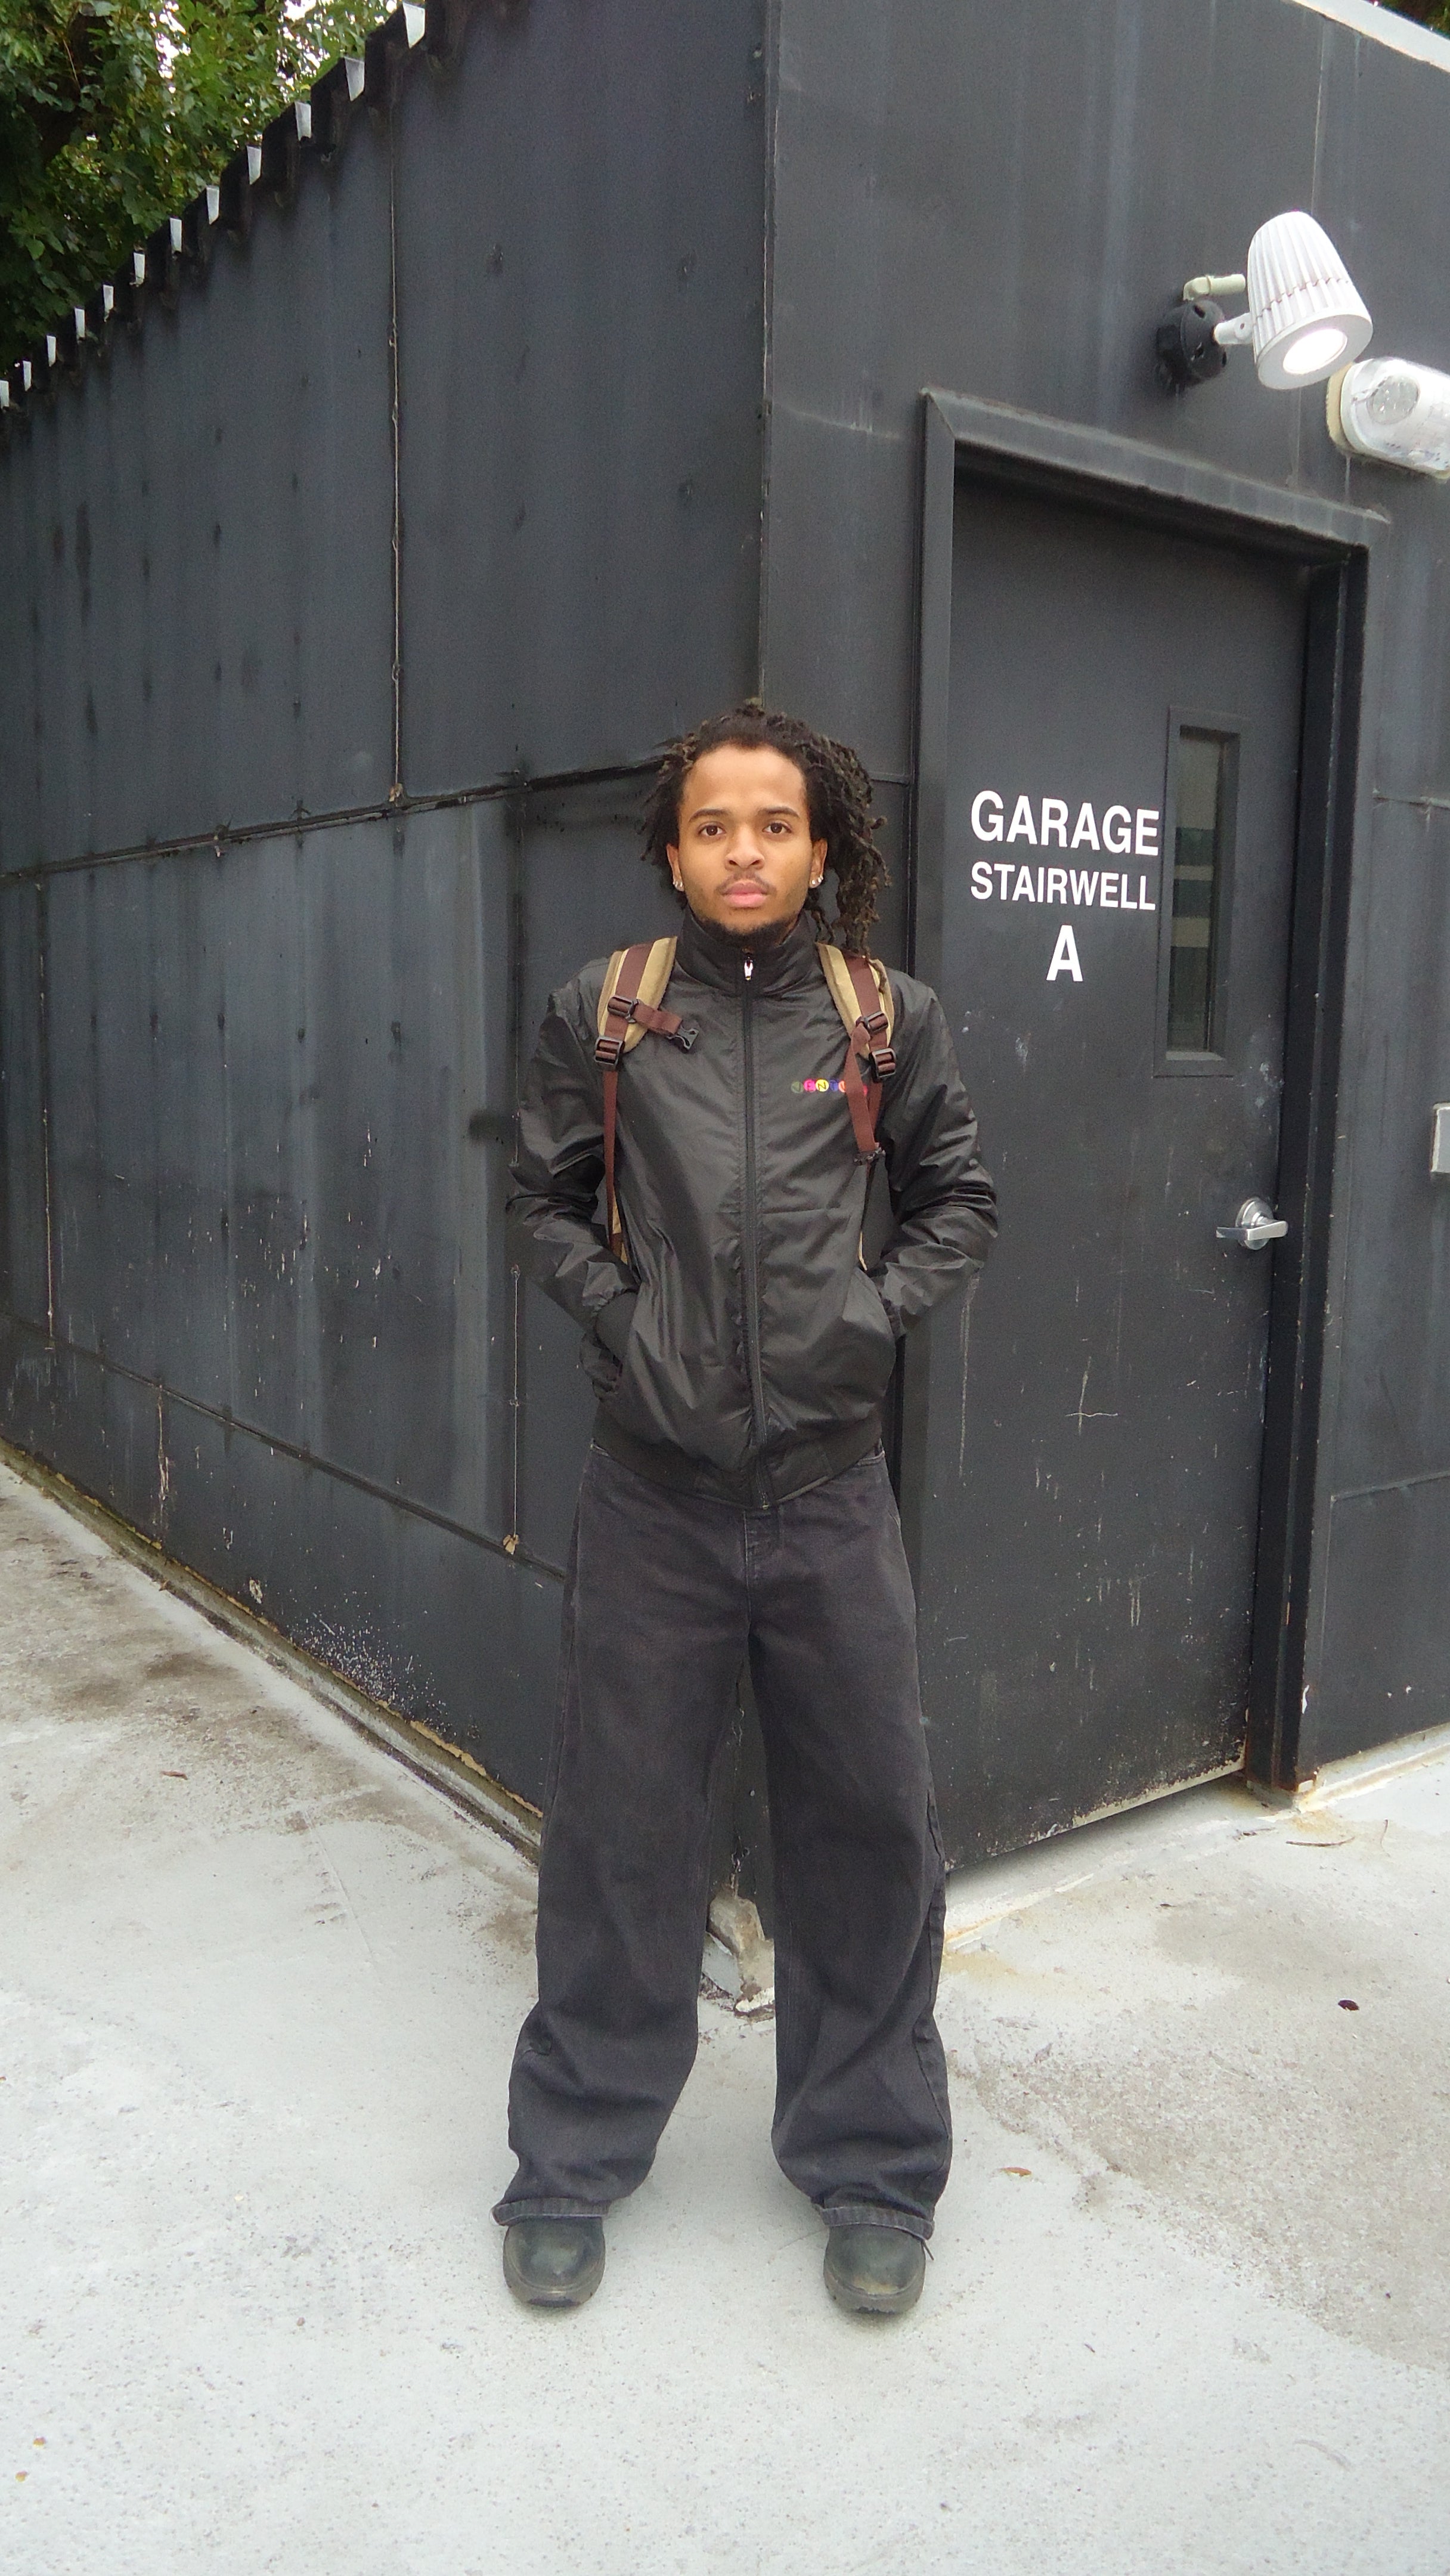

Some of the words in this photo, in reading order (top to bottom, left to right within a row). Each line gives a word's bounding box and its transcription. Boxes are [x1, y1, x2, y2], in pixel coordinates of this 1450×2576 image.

[971, 790, 1159, 856] GARAGE
[971, 861, 1155, 910] STAIRWELL
[1046, 924, 1083, 982] A
